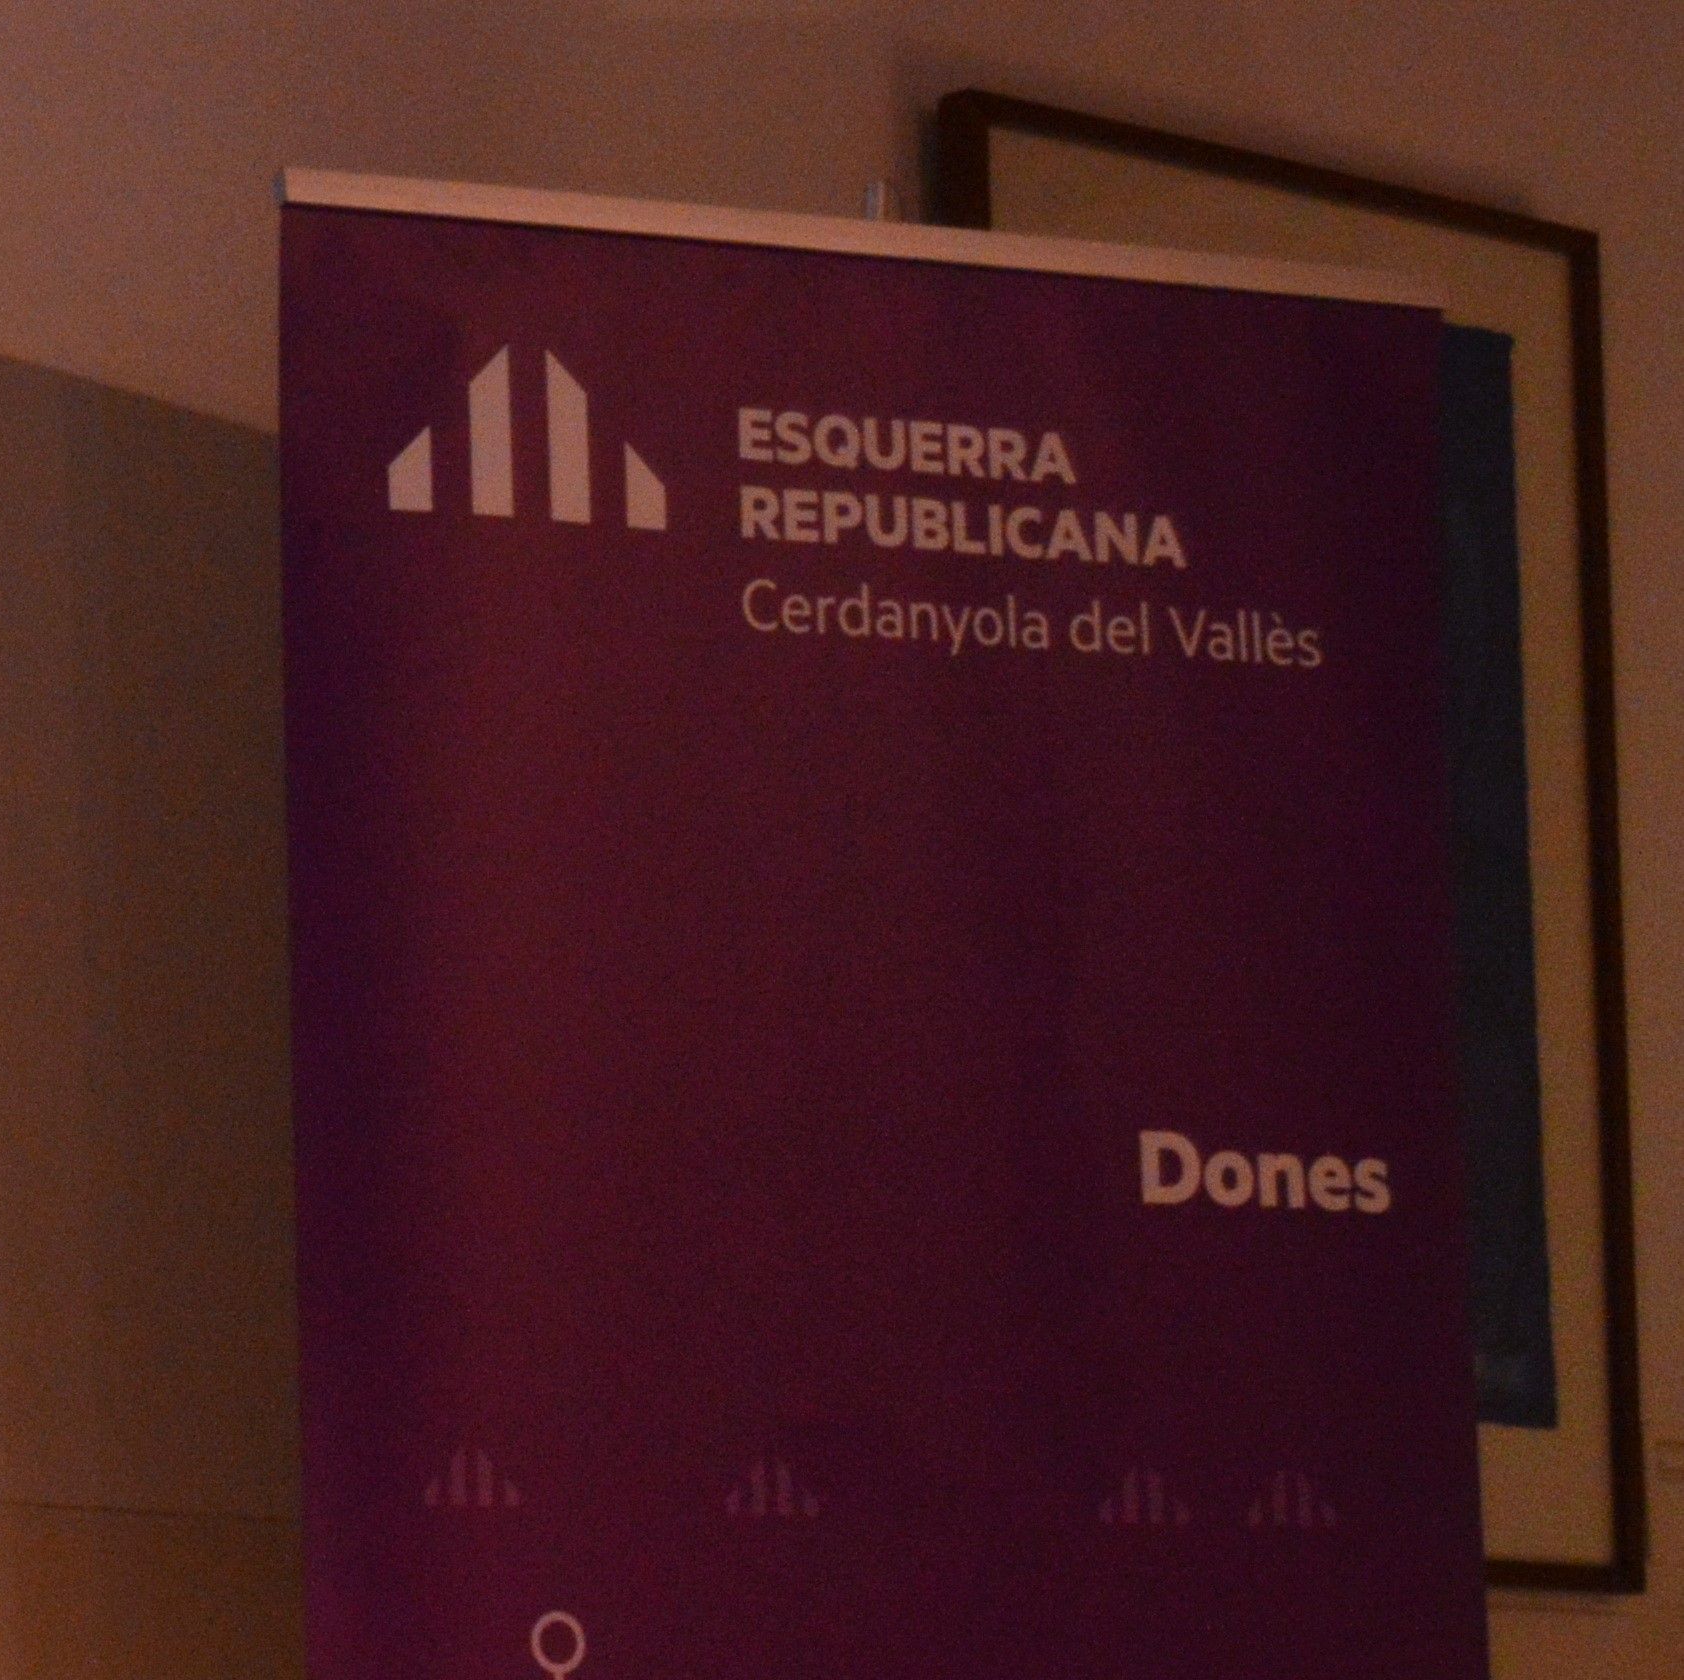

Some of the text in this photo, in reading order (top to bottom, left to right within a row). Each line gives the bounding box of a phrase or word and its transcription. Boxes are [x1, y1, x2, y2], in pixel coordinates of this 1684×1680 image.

[738, 407, 1077, 485] ESQUERRA
[739, 485, 1186, 568] REPUBLICANA
[741, 578, 1322, 668] Cerdanyola del Vallès
[1139, 1130, 1391, 1213] Dones
